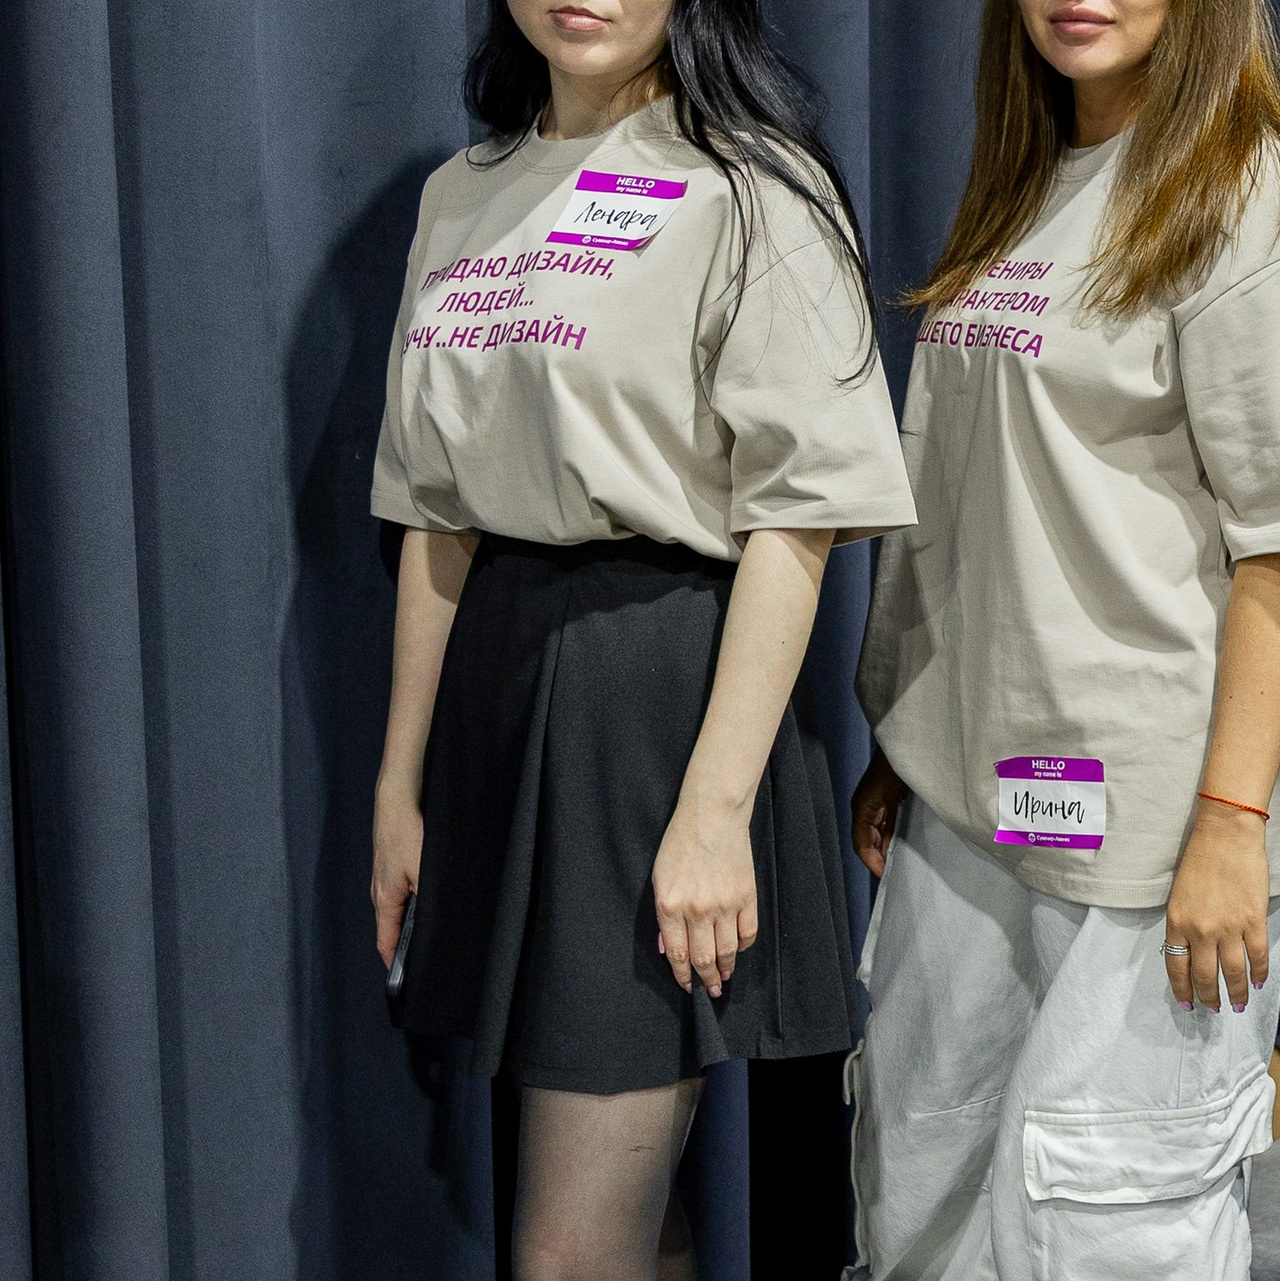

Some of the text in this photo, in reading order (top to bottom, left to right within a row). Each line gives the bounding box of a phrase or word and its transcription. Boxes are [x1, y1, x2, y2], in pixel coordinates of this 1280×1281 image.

[616, 177, 656, 188] HELLO
[574, 201, 658, 231] Ленара
[509, 250, 615, 280] ДИЗАЙН,
[987, 259, 1054, 280] ЕНИРЫ
[437, 282, 534, 315] ЛЮДЕЙ...
[942, 289, 1050, 317] РАКТЕРОМ
[482, 315, 587, 352] ДИЗАЙН
[917, 321, 1043, 358] ШЕГО БИЗНЕСА
[1032, 760, 1065, 770] HELLO
[1013, 791, 1085, 824] Ирина
